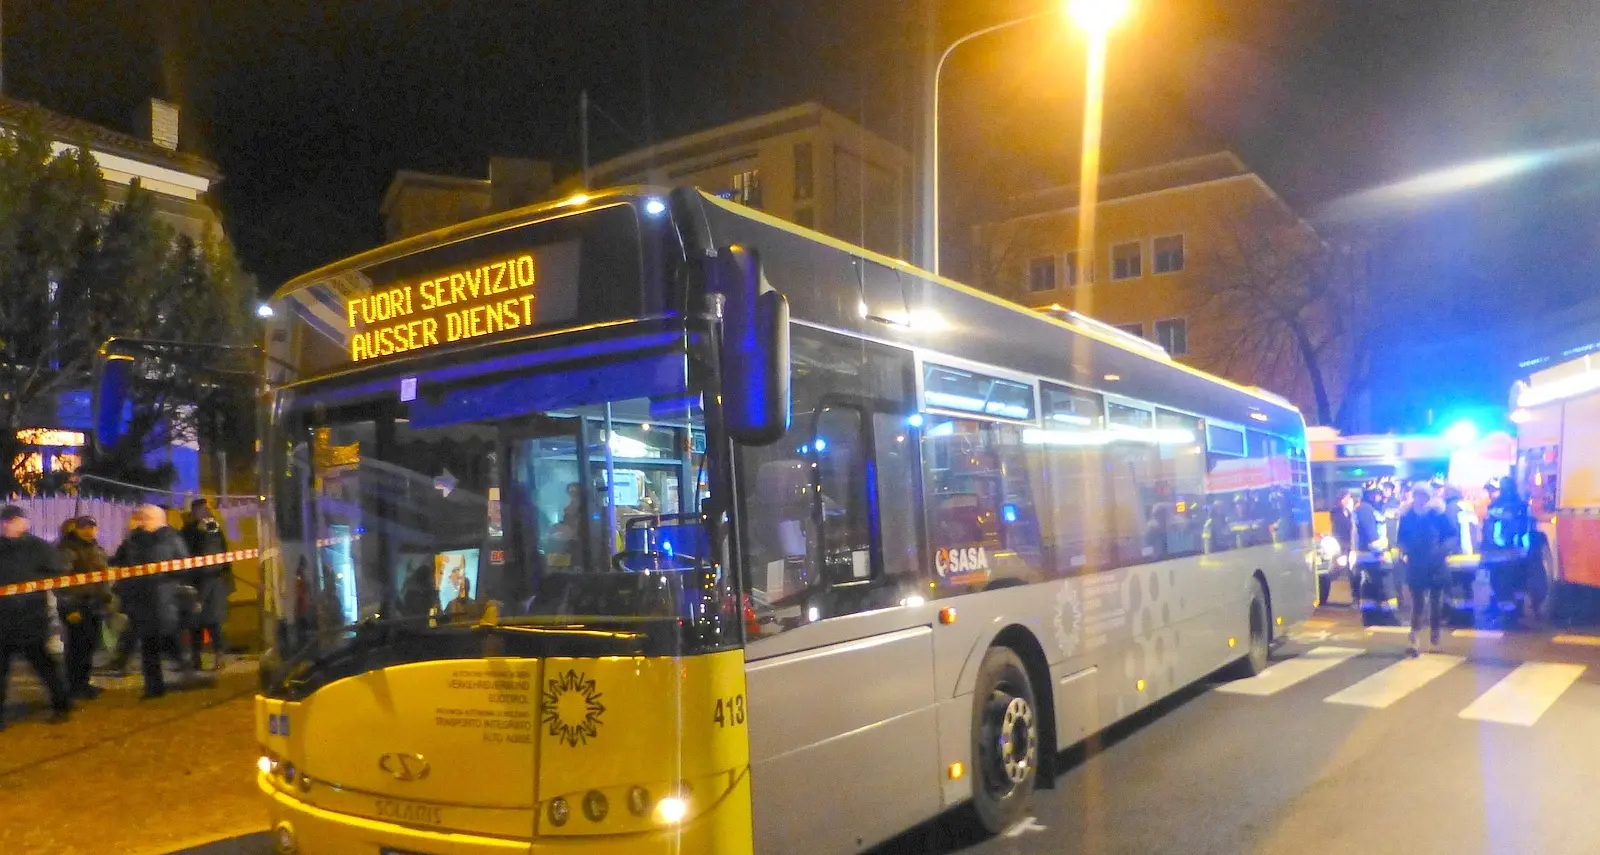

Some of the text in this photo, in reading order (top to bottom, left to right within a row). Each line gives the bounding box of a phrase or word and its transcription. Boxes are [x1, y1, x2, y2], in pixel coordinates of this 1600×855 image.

[348, 255, 535, 328] FUORI SERVIZIO
[352, 294, 535, 362] AUSSER DIENST
[949, 547, 989, 573] SASA
[713, 694, 745, 728] 413
